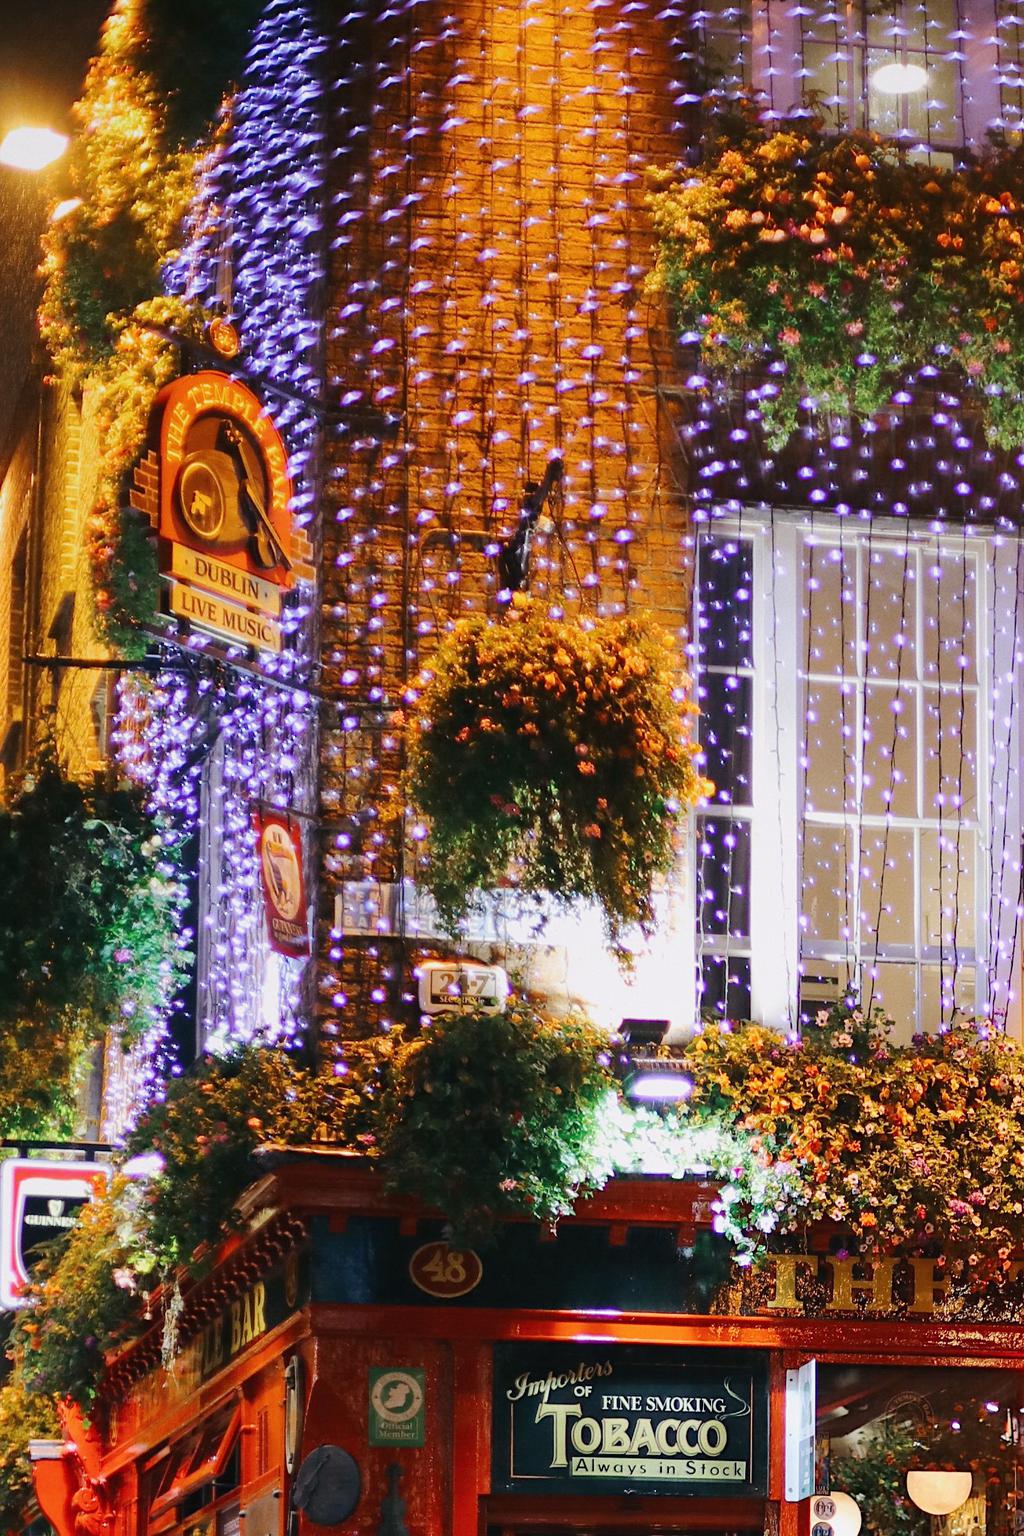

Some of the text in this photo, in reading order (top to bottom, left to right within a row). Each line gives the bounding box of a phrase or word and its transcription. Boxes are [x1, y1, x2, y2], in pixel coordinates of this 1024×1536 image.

[166, 382, 286, 511] THE TEMPLE BAR
[193, 556, 261, 600] DUBLIN
[180, 591, 272, 643] LIVE MUSIC
[421, 1250, 467, 1284] 48
[507, 1360, 613, 1405] Importers
[573, 1385, 593, 1398] OF
[601, 1394, 727, 1414] FINE SMOKING
[378, 1421, 413, 1431] Official
[378, 1430, 416, 1440] Member
[534, 1402, 728, 1469] TOBACCO
[575, 1460, 743, 1477] Always in Stock
